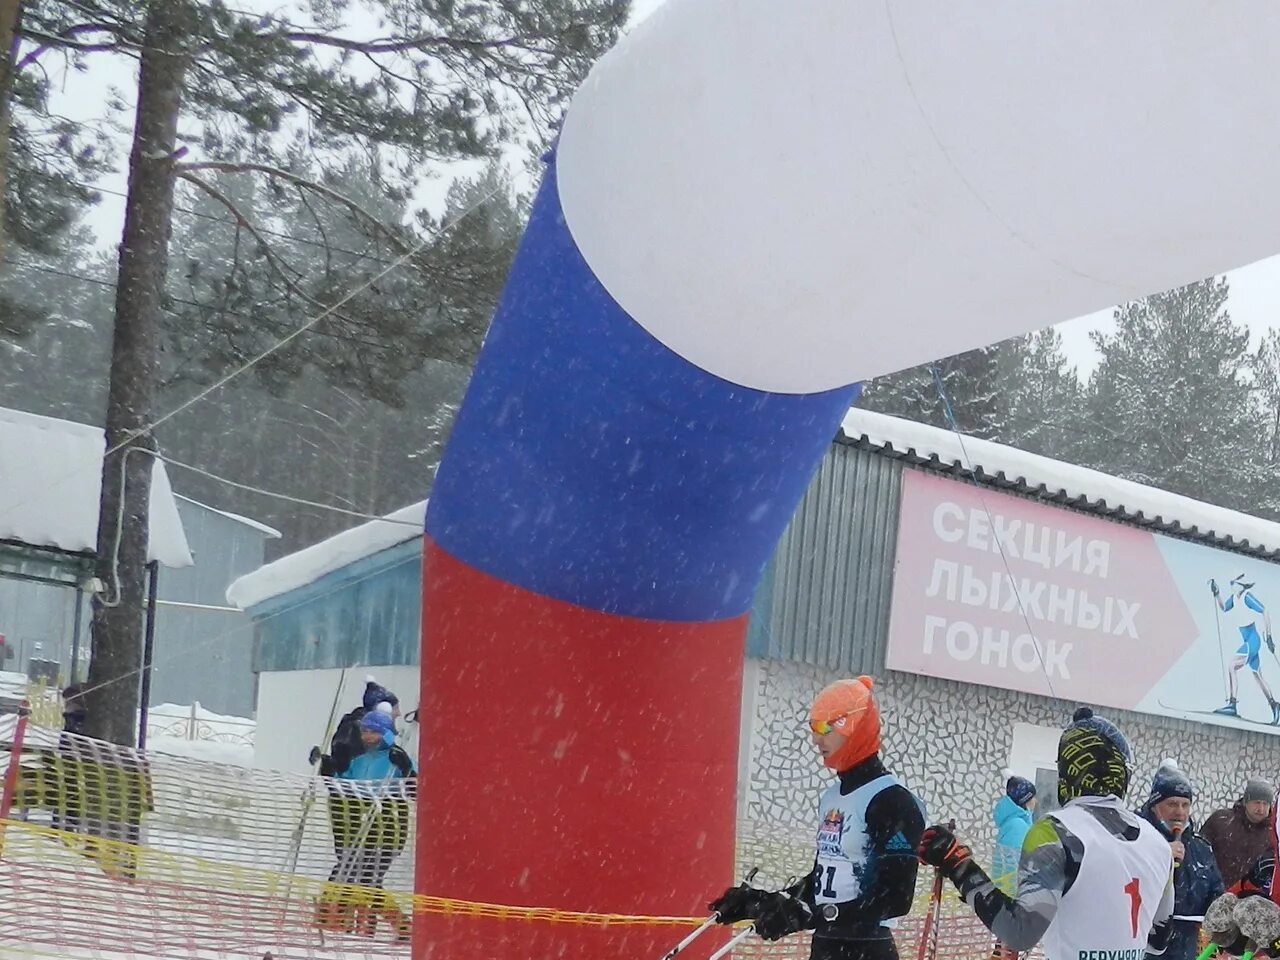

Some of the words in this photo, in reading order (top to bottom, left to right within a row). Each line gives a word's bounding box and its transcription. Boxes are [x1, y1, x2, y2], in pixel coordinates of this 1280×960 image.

[933, 502, 1111, 578] СЕКЦИЯ
[926, 558, 1141, 640] ЛЫЖНЫХ
[922, 614, 1074, 680] ГОНОК
[1124, 877, 1142, 939] 1
